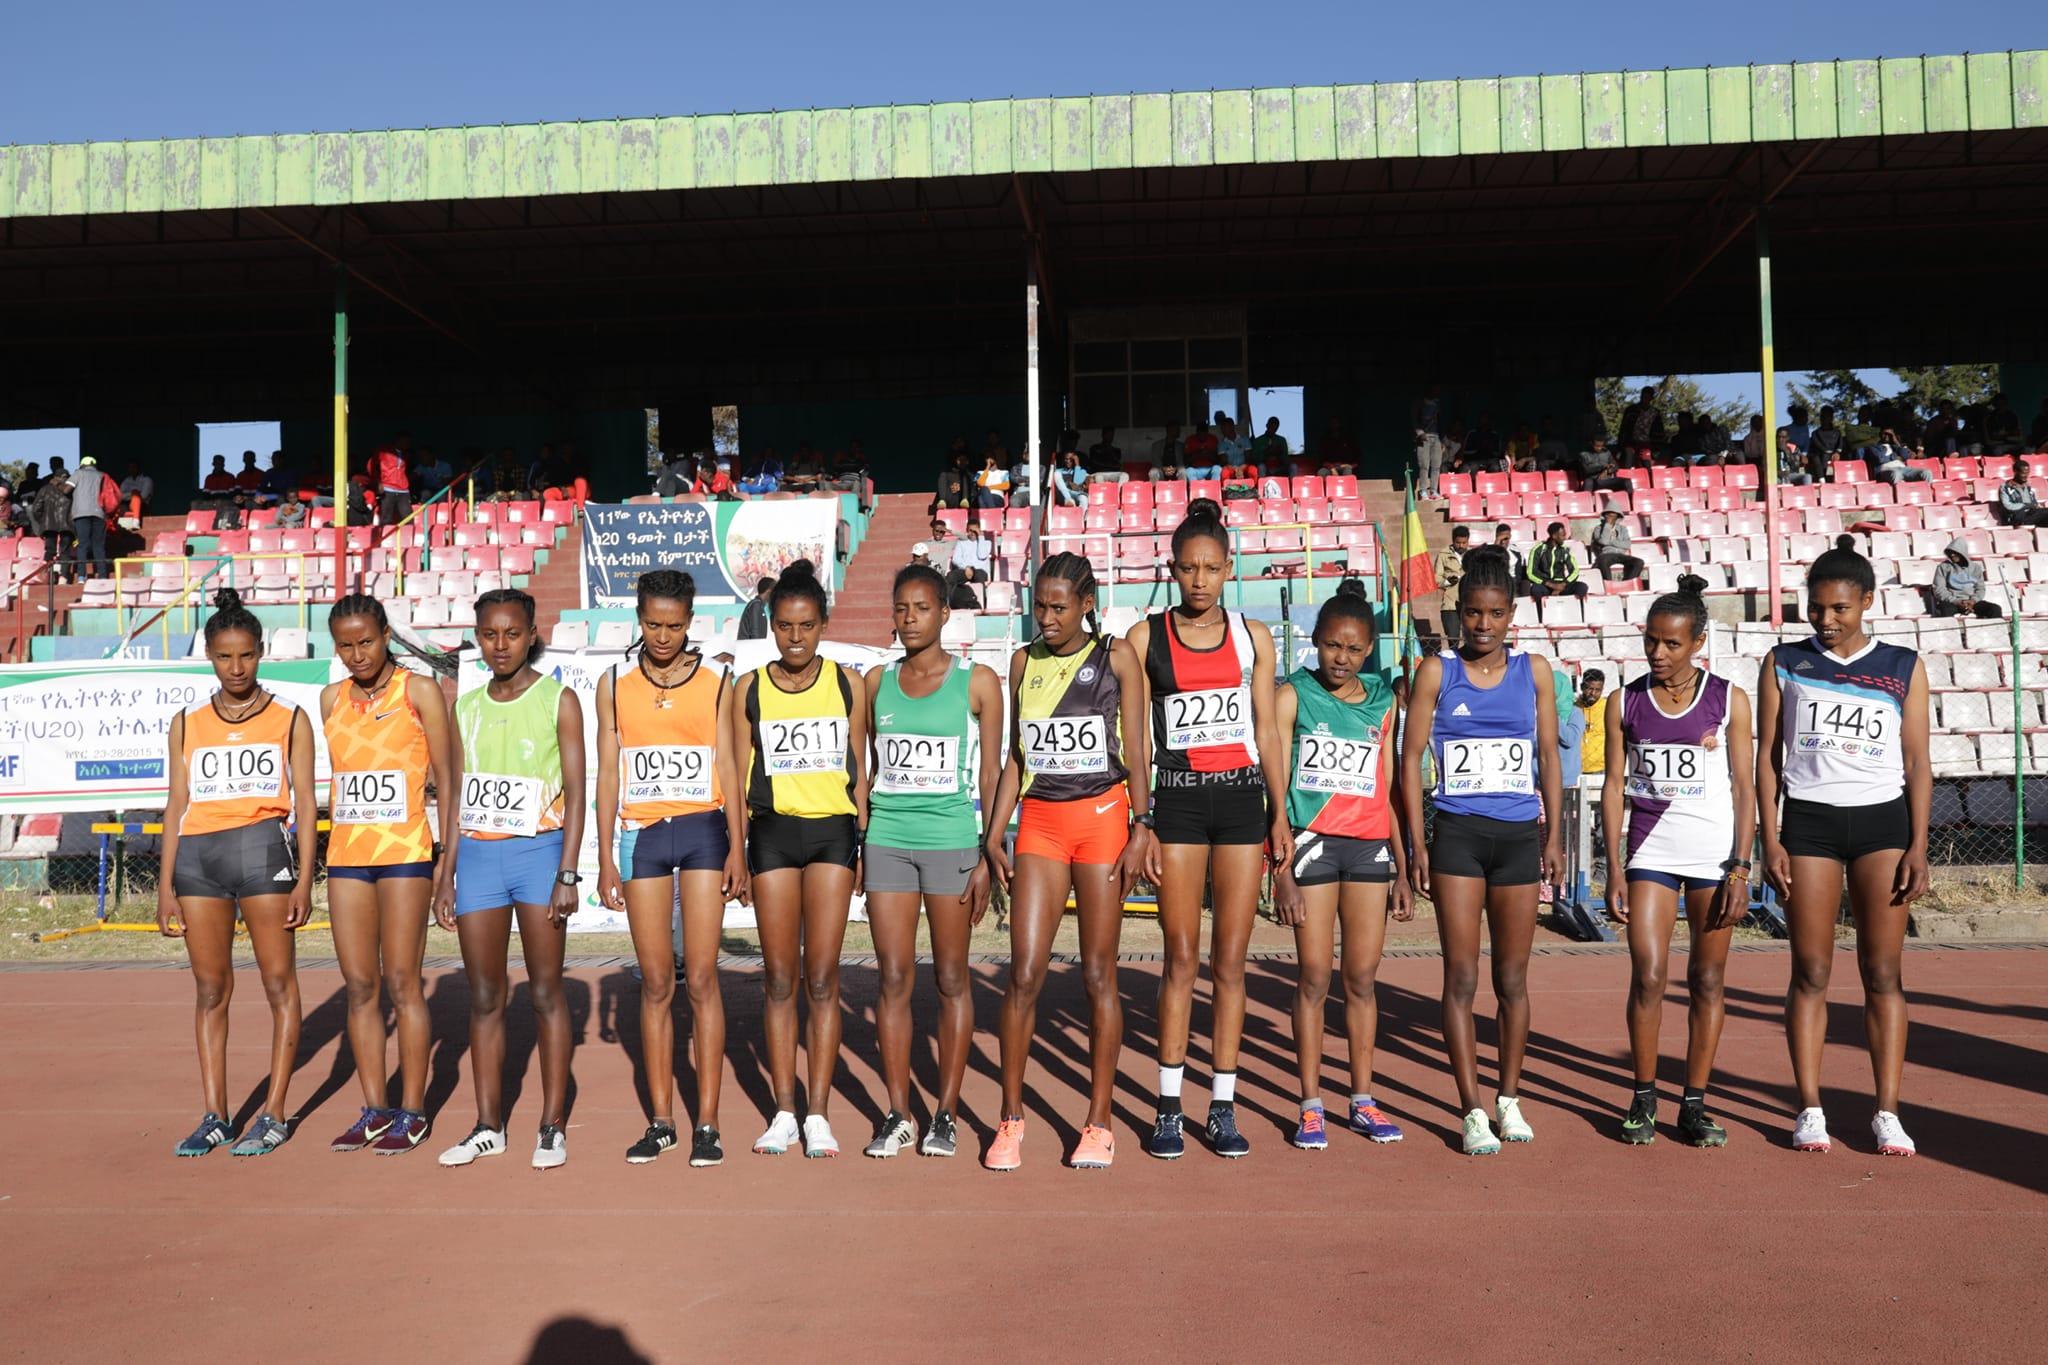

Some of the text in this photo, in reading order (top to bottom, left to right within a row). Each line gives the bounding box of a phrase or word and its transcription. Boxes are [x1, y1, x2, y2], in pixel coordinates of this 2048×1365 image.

[638, 509, 706, 525] የኢትዮጵያ
[627, 530, 667, 545] ዓመት
[674, 530, 710, 545] በታች
[1173, 692, 1239, 728] 2226
[1808, 702, 1882, 739] 1446
[772, 721, 838, 752] 2611
[1027, 721, 1096, 752] 2436
[202, 750, 274, 778] 0106
[635, 751, 702, 781] 0959
[1304, 738, 1372, 774] 2887
[1632, 749, 1696, 778] 2518
[341, 775, 396, 803] 1405
[467, 778, 529, 811] 0882
